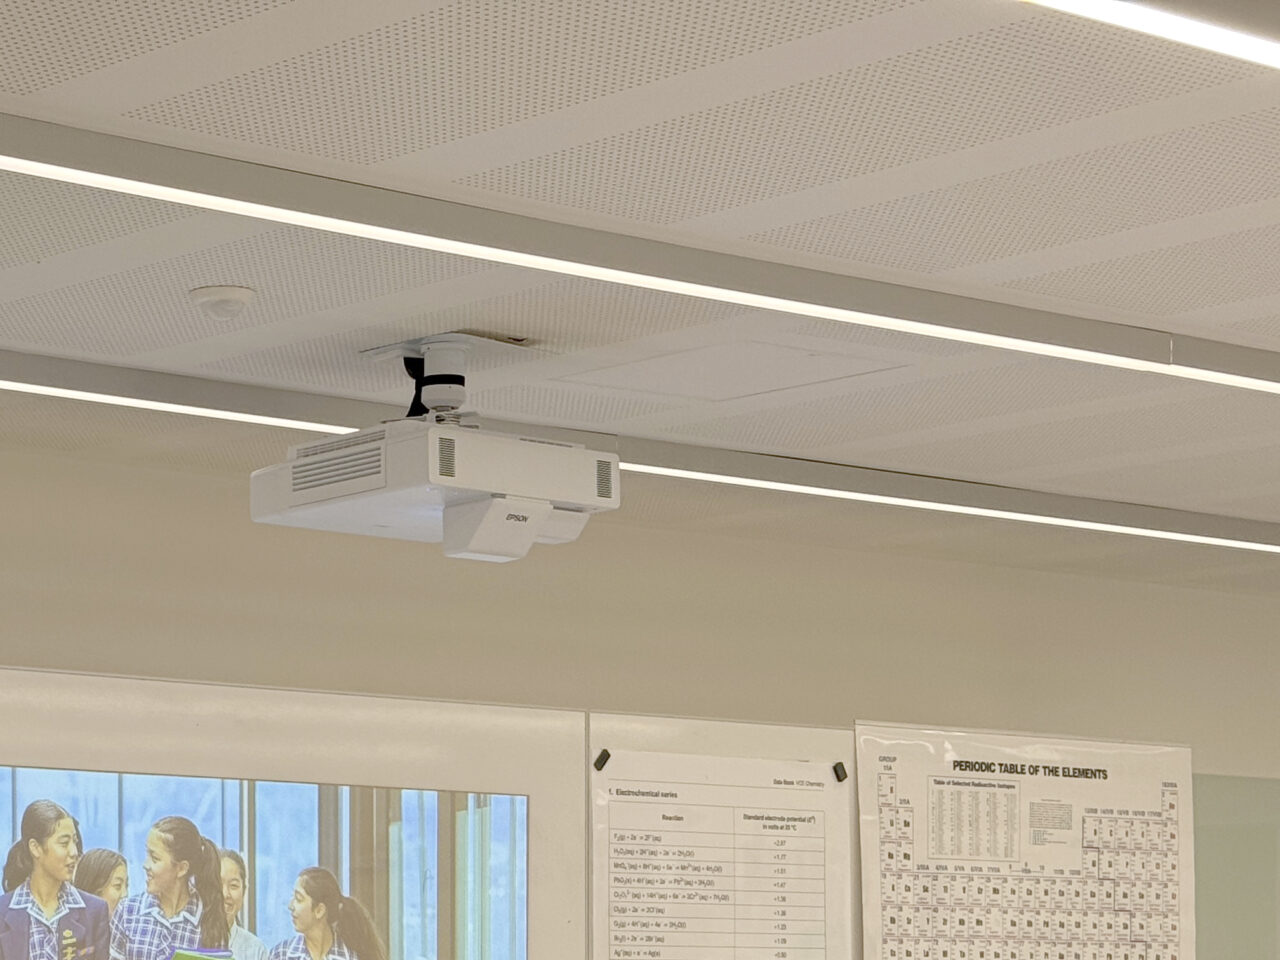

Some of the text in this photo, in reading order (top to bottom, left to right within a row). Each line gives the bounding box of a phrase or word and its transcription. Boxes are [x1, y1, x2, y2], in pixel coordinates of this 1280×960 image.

[506, 513, 528, 522] EPSON
[953, 760, 1108, 780] PERIODIC TABLE OF THE ELEMENTS
